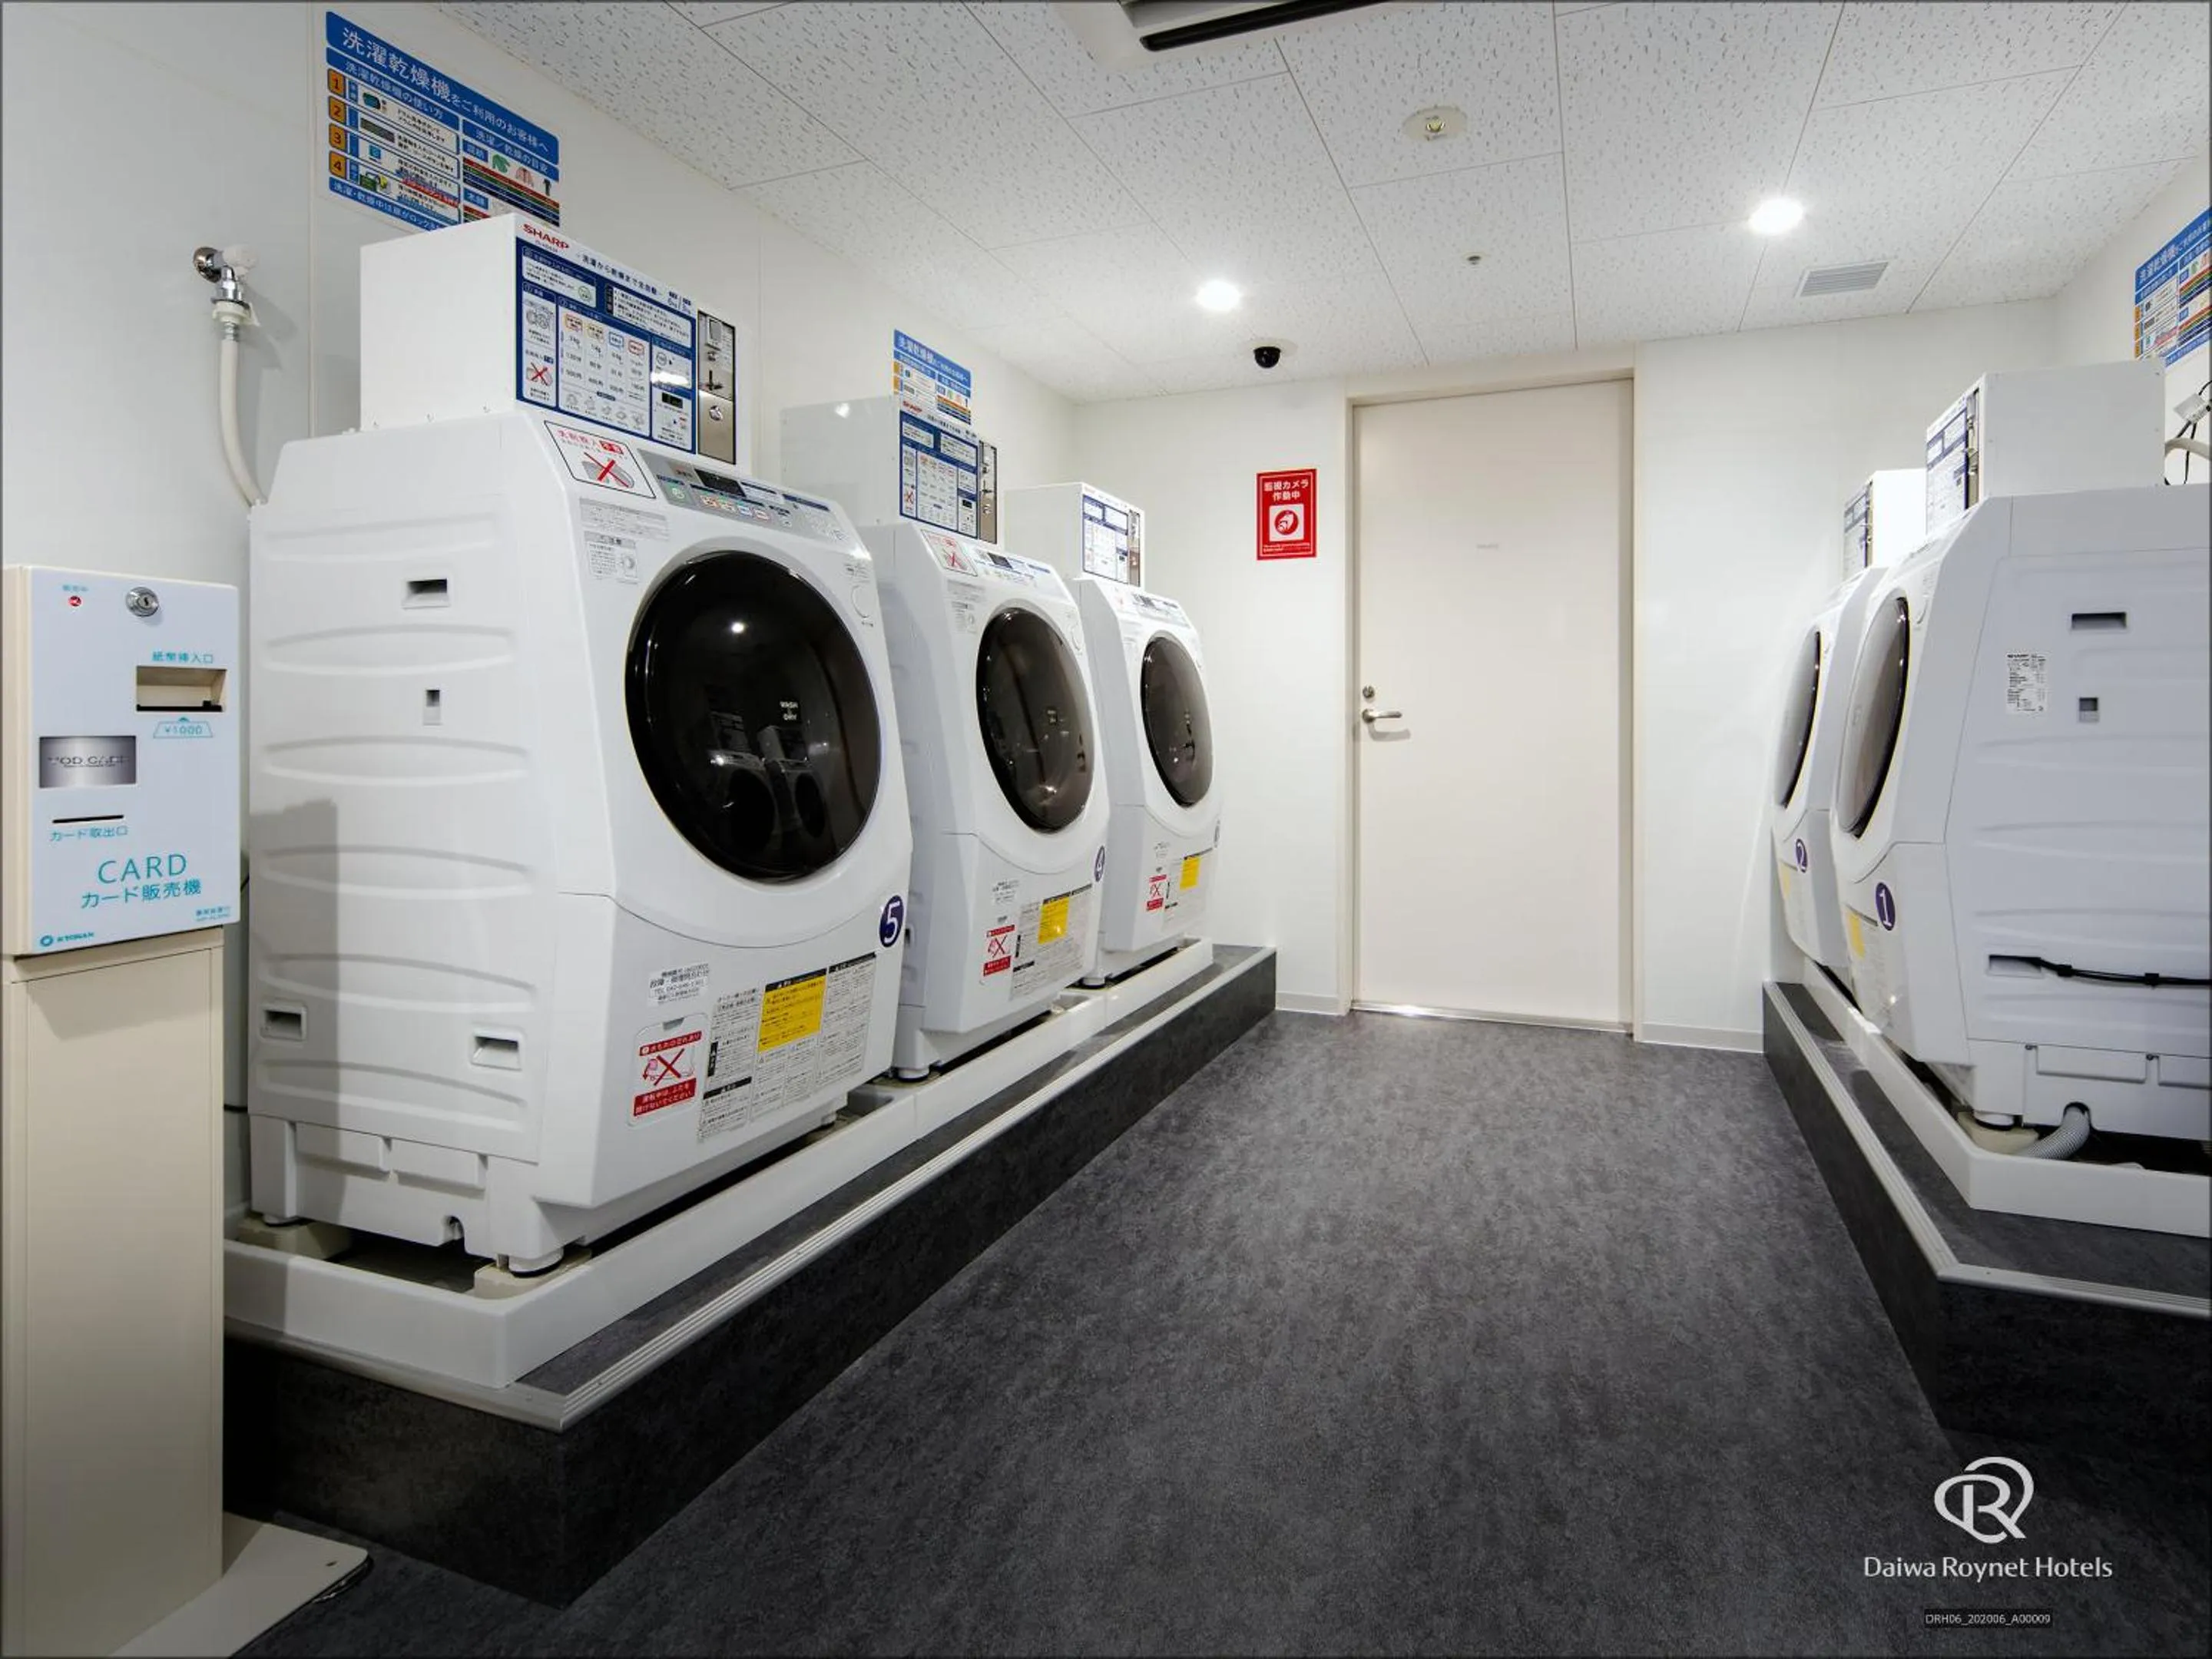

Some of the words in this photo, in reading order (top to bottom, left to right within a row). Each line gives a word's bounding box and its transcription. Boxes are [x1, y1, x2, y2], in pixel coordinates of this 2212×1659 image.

[343, 27, 548, 153] 洗濯乾燥機をご利用のお客様へ
[333, 104, 342, 116] 2
[333, 131, 342, 144] 3
[333, 160, 342, 172] 4
[522, 224, 569, 250] SHARP
[98, 853, 187, 884] CARD
[1796, 842, 1806, 869] 2
[81, 879, 201, 909] カード販売機
[1879, 888, 1892, 927] 1
[884, 900, 900, 944] 5
